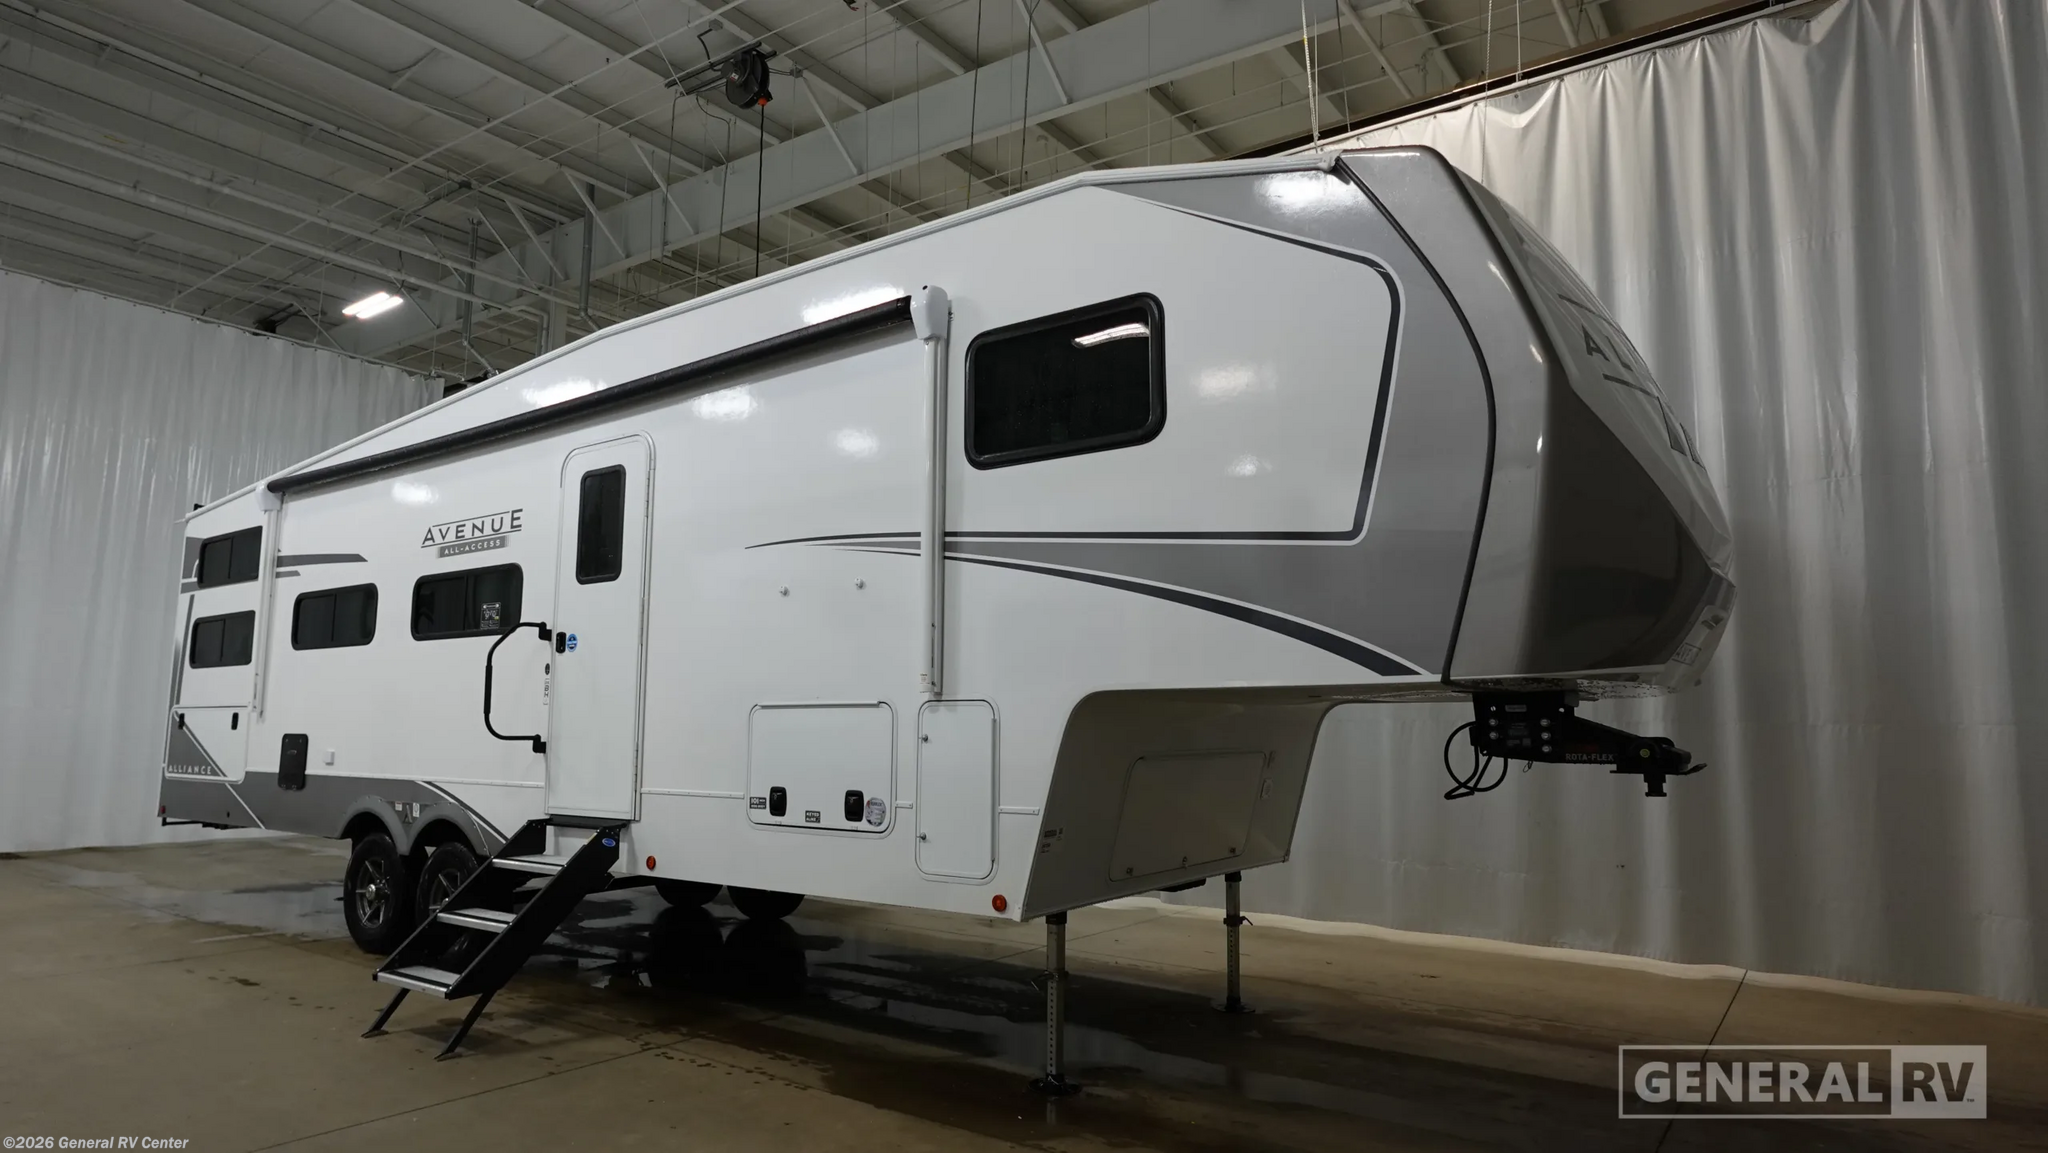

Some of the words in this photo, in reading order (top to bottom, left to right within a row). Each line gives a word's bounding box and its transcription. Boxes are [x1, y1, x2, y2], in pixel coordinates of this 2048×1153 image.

[421, 508, 524, 546] AVENUE
[444, 539, 501, 555] ALL-ACCESS
[168, 764, 212, 775] ALLIANCE
